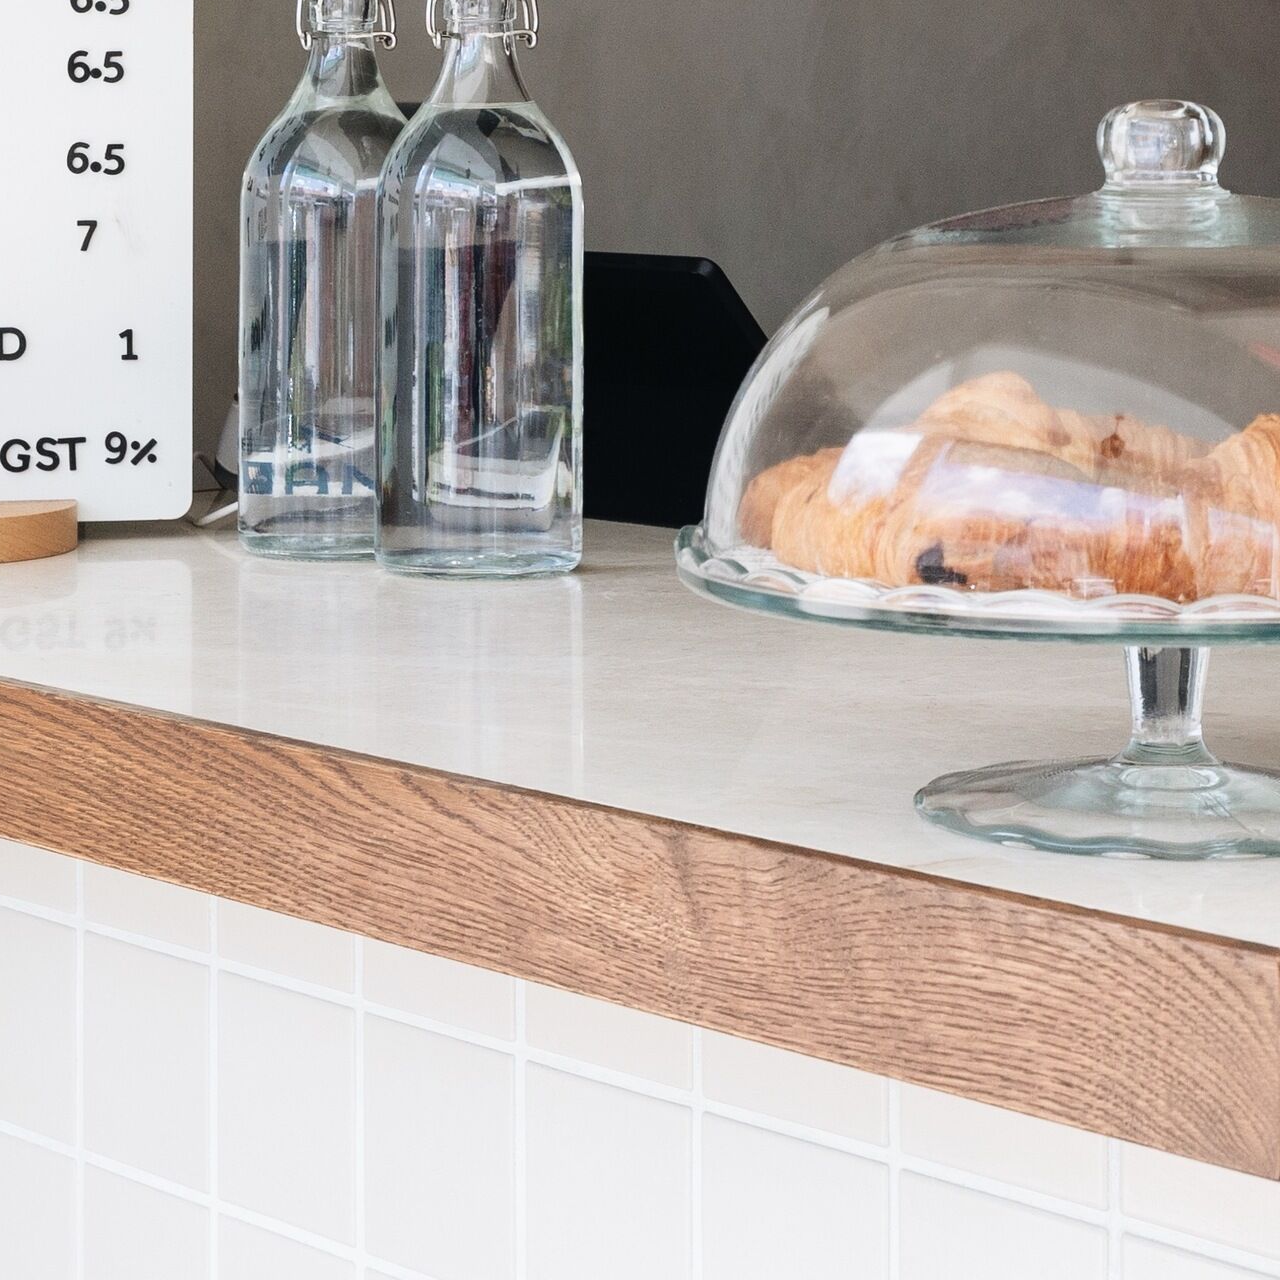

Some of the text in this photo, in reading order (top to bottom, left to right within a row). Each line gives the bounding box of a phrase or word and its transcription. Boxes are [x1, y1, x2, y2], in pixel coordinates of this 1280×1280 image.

[68, 51, 124, 83] 6.5
[67, 142, 125, 175] 6.5
[76, 220, 98, 251] 7
[119, 329, 138, 360] 1
[0, 431, 157, 472] GST 9%
